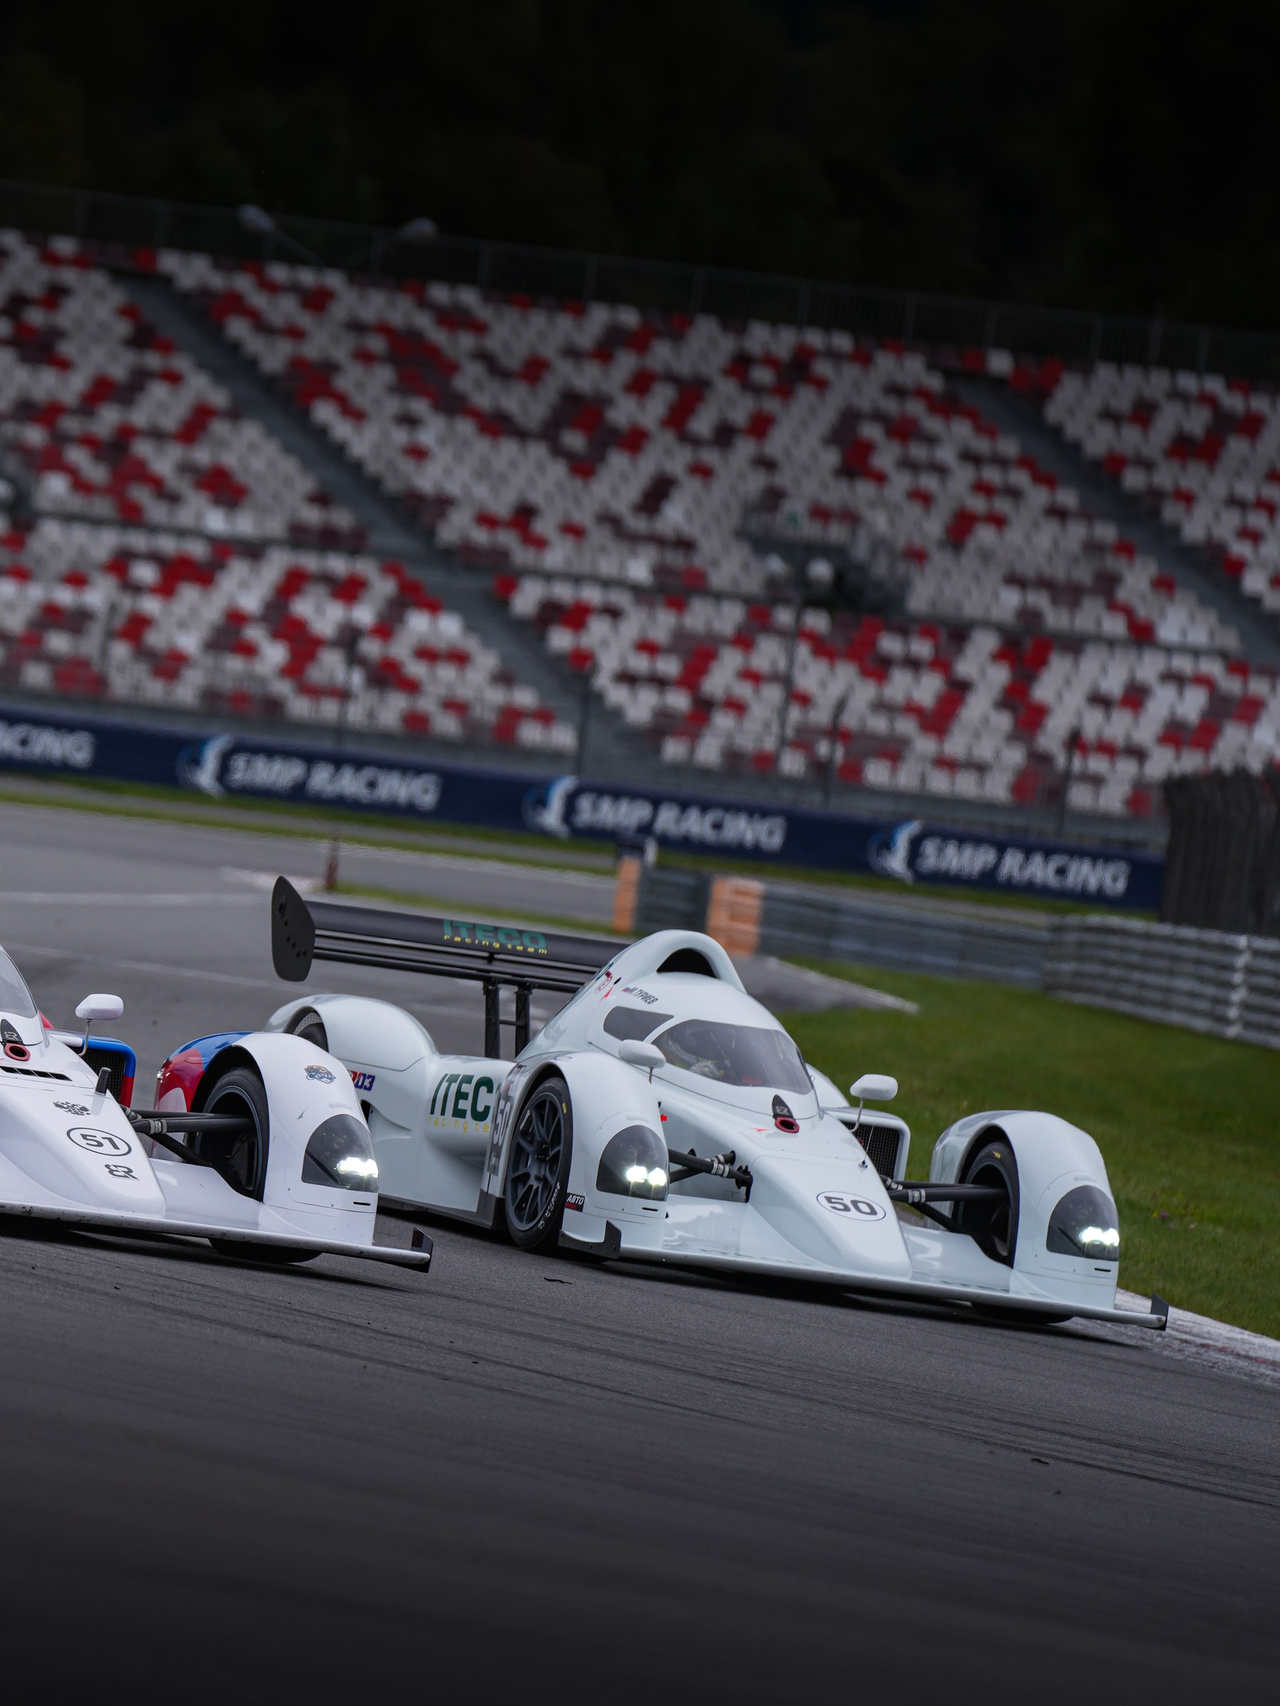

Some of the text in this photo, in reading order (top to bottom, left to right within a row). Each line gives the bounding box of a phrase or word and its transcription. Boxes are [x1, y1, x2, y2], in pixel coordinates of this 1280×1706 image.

[225, 752, 443, 812] SMP RACING
[572, 793, 787, 852] SMP RACING
[917, 837, 1132, 897] SMP RACING
[443, 919, 547, 949] ITECO
[443, 934, 500, 949] racing
[429, 1073, 501, 1123] ITEC
[427, 1116, 491, 1134] racing te
[493, 1100, 512, 1147] 50
[80, 1132, 121, 1151] 51
[566, 1194, 585, 1205] АВТО
[825, 1195, 878, 1217] 50
